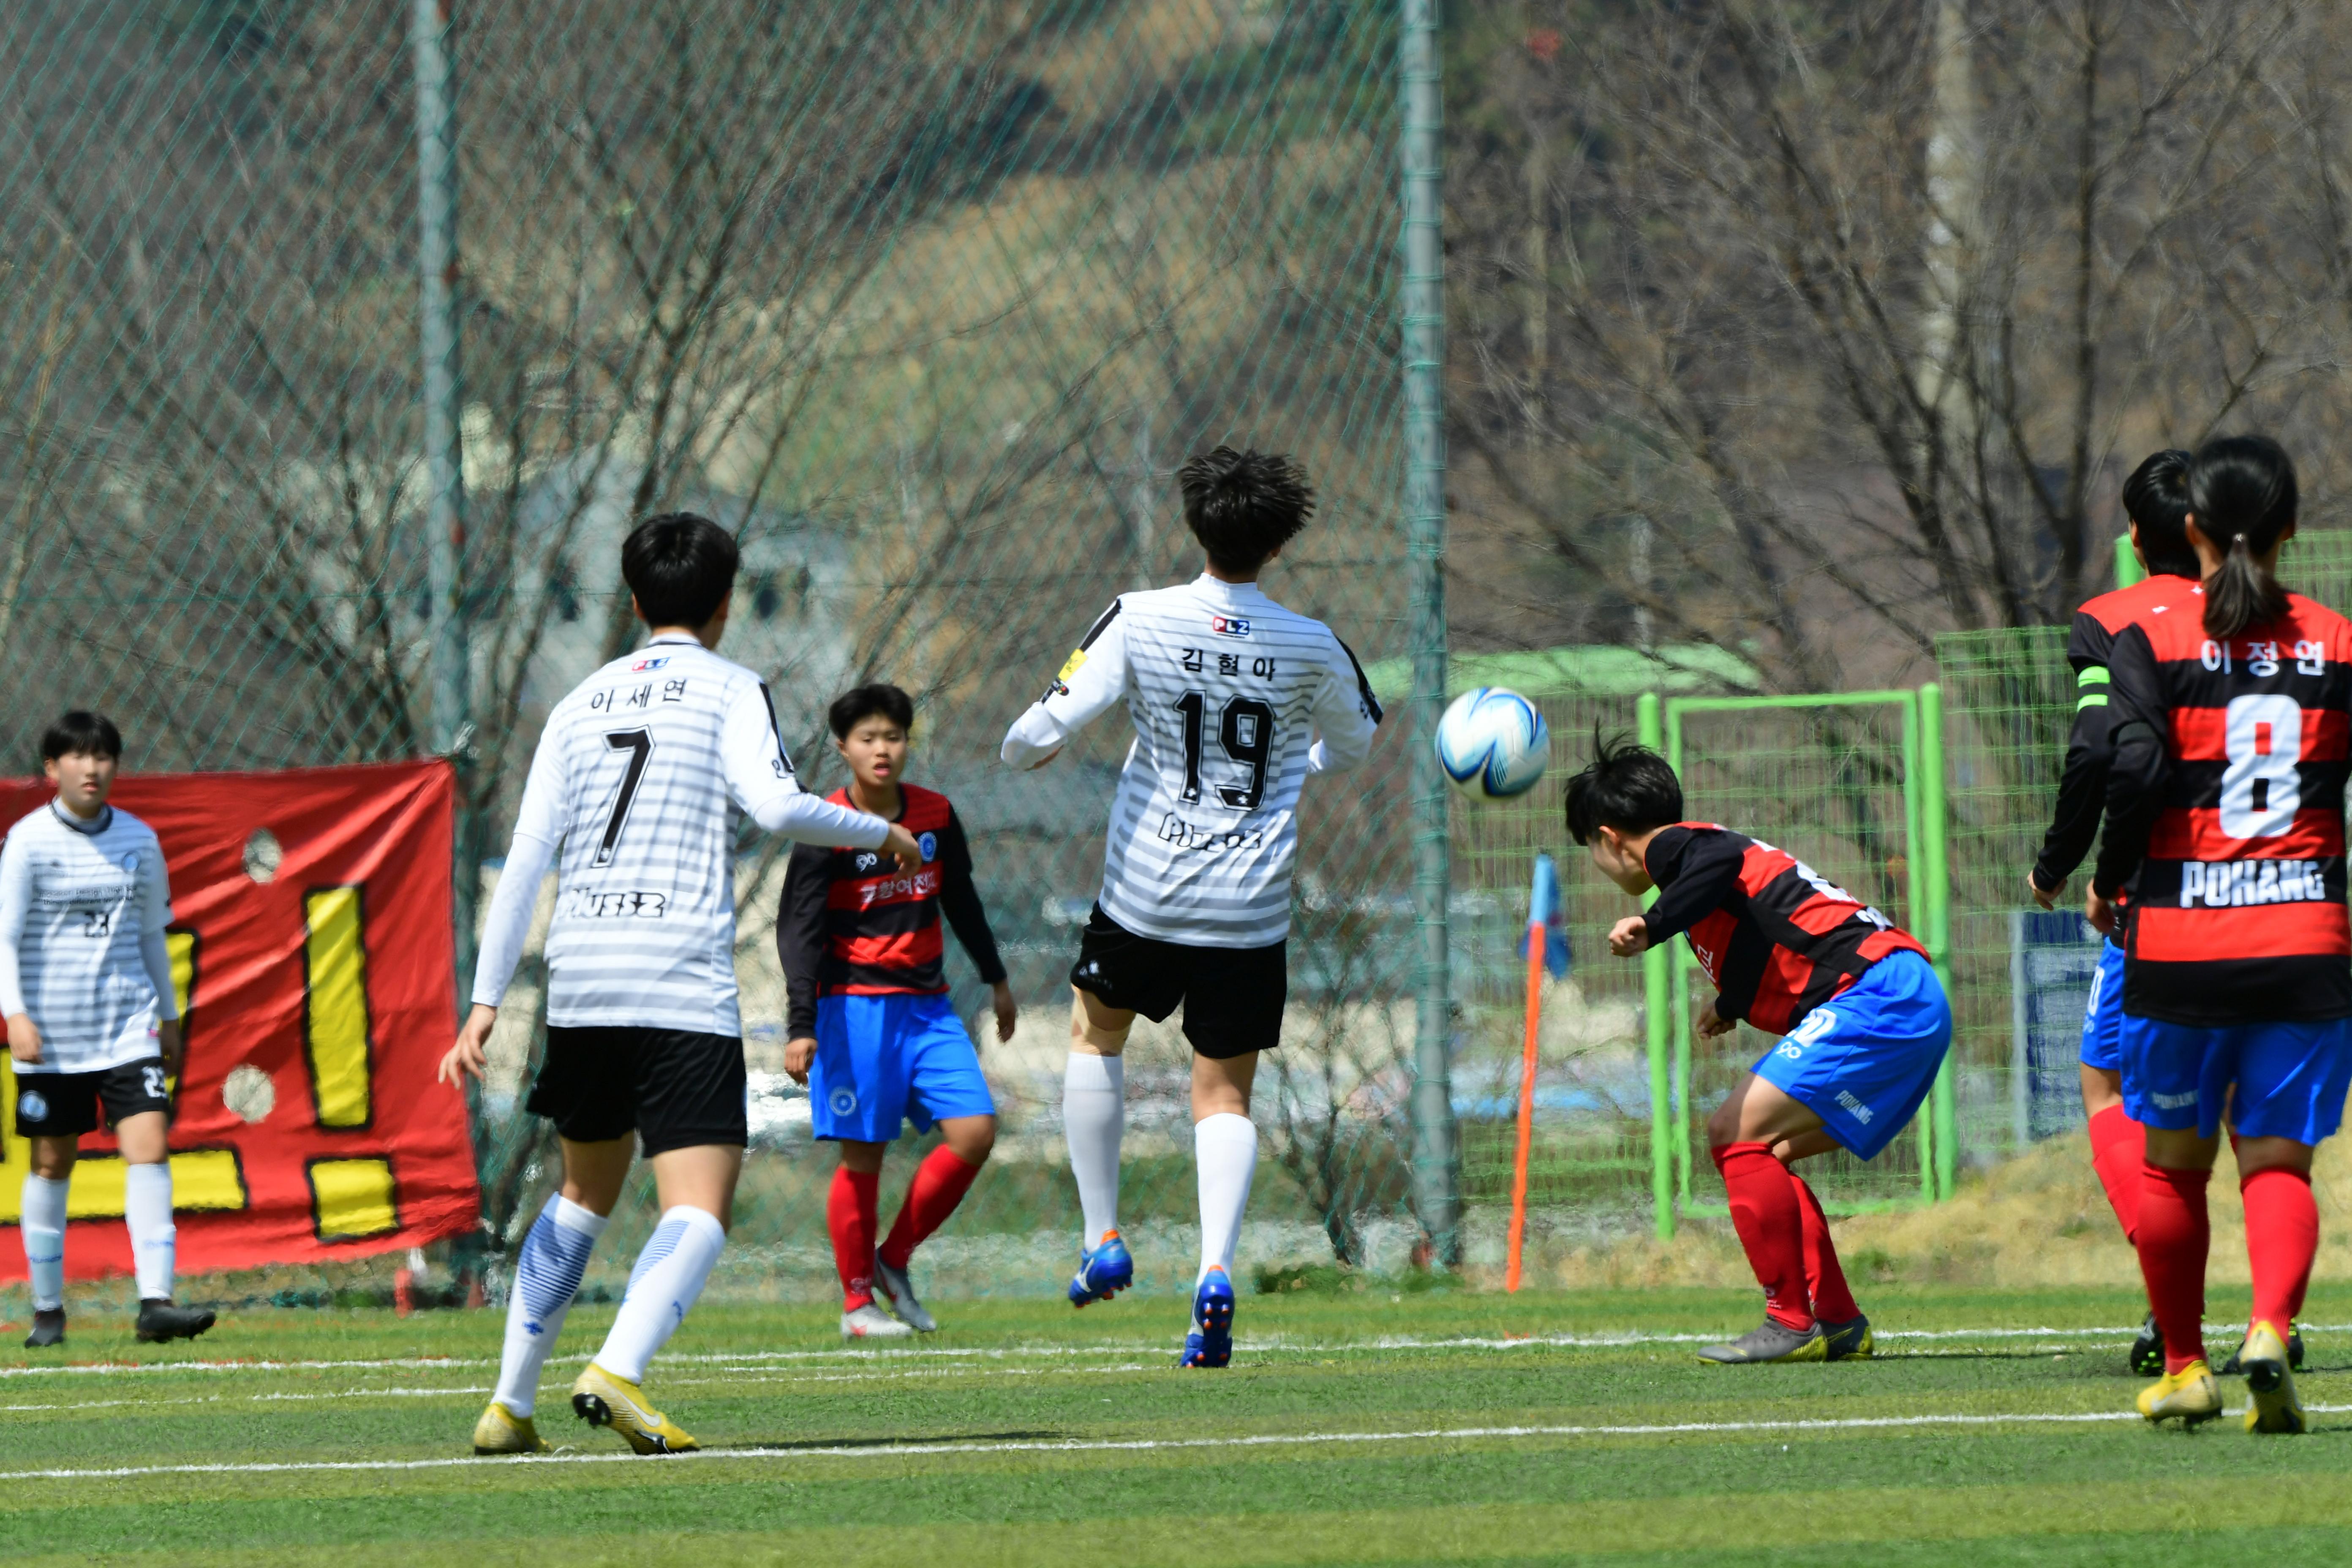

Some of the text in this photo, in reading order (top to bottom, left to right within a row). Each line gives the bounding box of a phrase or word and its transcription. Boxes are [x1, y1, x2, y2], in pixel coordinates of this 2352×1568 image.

[1213, 617, 1250, 634] PLZ
[1182, 648, 1276, 681] 김현아
[2201, 639, 2325, 677] 이정연
[591, 678, 687, 712] 이세연
[1173, 689, 1276, 811] 19
[2219, 694, 2301, 839] 8
[591, 724, 656, 868] 7
[2180, 860, 2325, 908] POHANG
[1776, 1041, 1802, 1059] 90
[1834, 1089, 1874, 1125] POHANG
